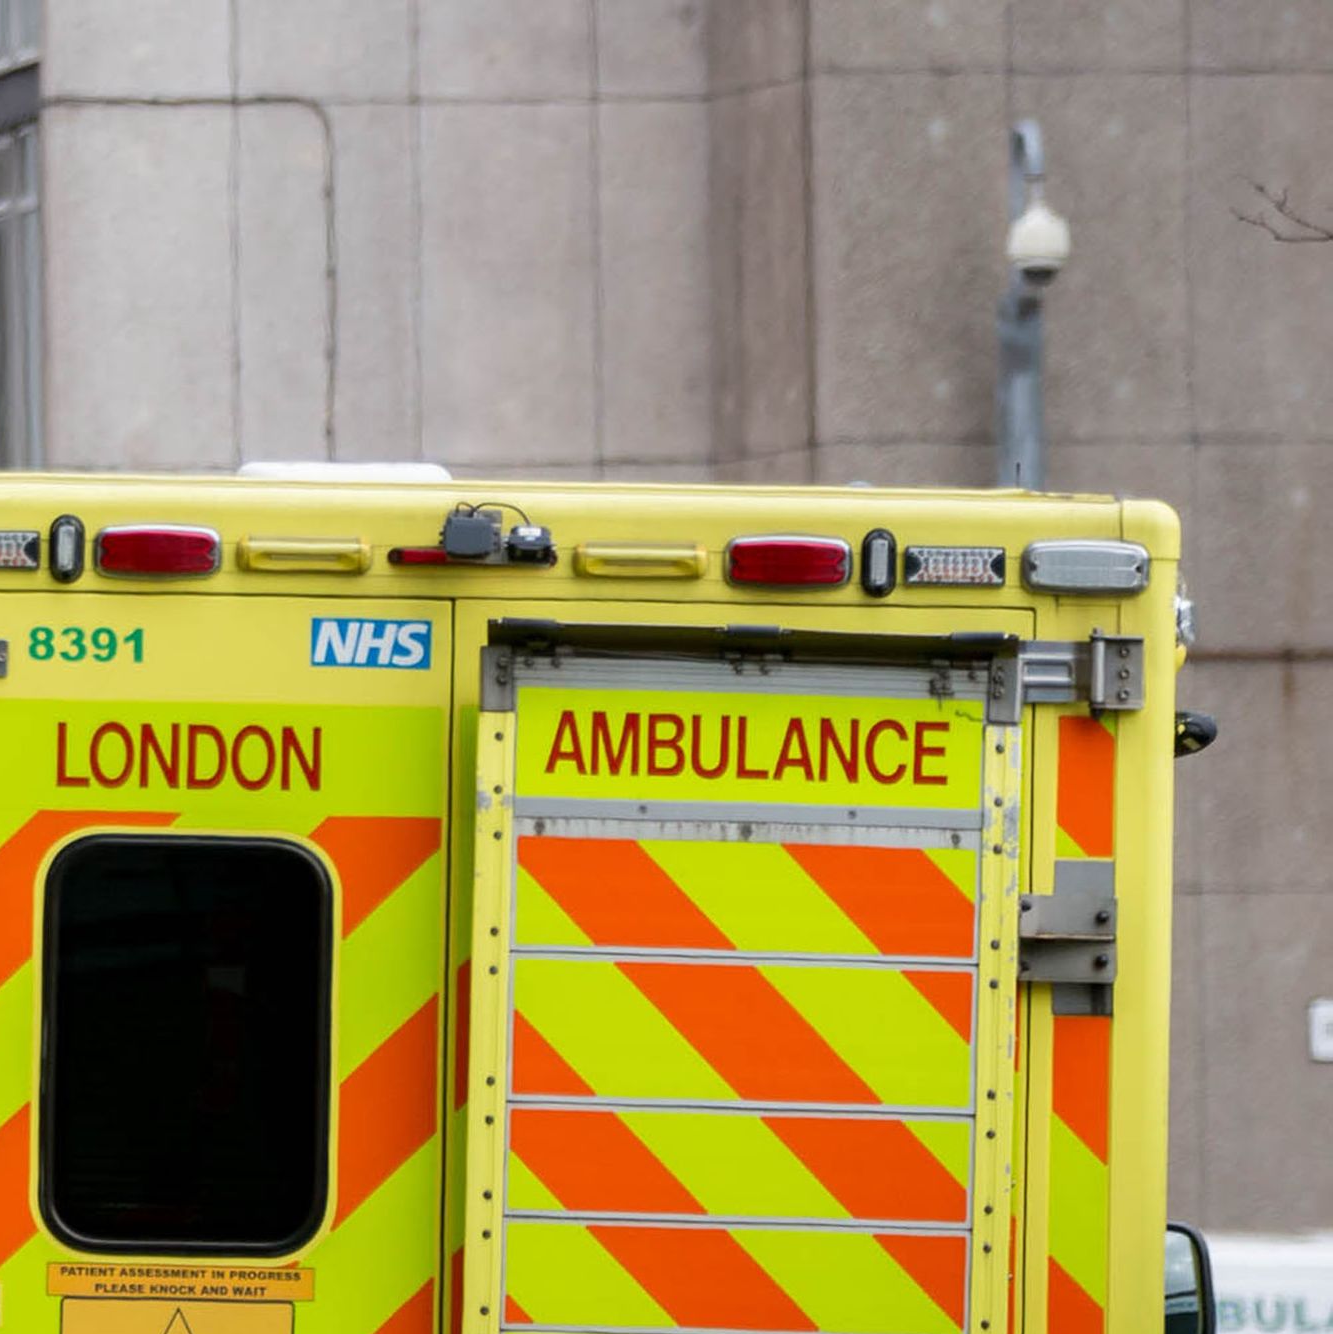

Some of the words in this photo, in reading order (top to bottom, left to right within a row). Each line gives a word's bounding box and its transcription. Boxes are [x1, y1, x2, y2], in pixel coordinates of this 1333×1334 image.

[27, 626, 145, 663] 8391
[314, 620, 430, 668] NHS
[55, 721, 322, 792] LONDON
[544, 710, 950, 786] AMBULANCE
[60, 1266, 115, 1277] PATIENT
[119, 1268, 207, 1279] ASSESSMENT
[211, 1270, 225, 1279] IN
[229, 1270, 301, 1281] PROGRESS
[94, 1283, 144, 1294] PLEASE
[149, 1285, 196, 1295] KNOCK
[200, 1286, 228, 1296] AND
[232, 1286, 267, 1296] WAIT
